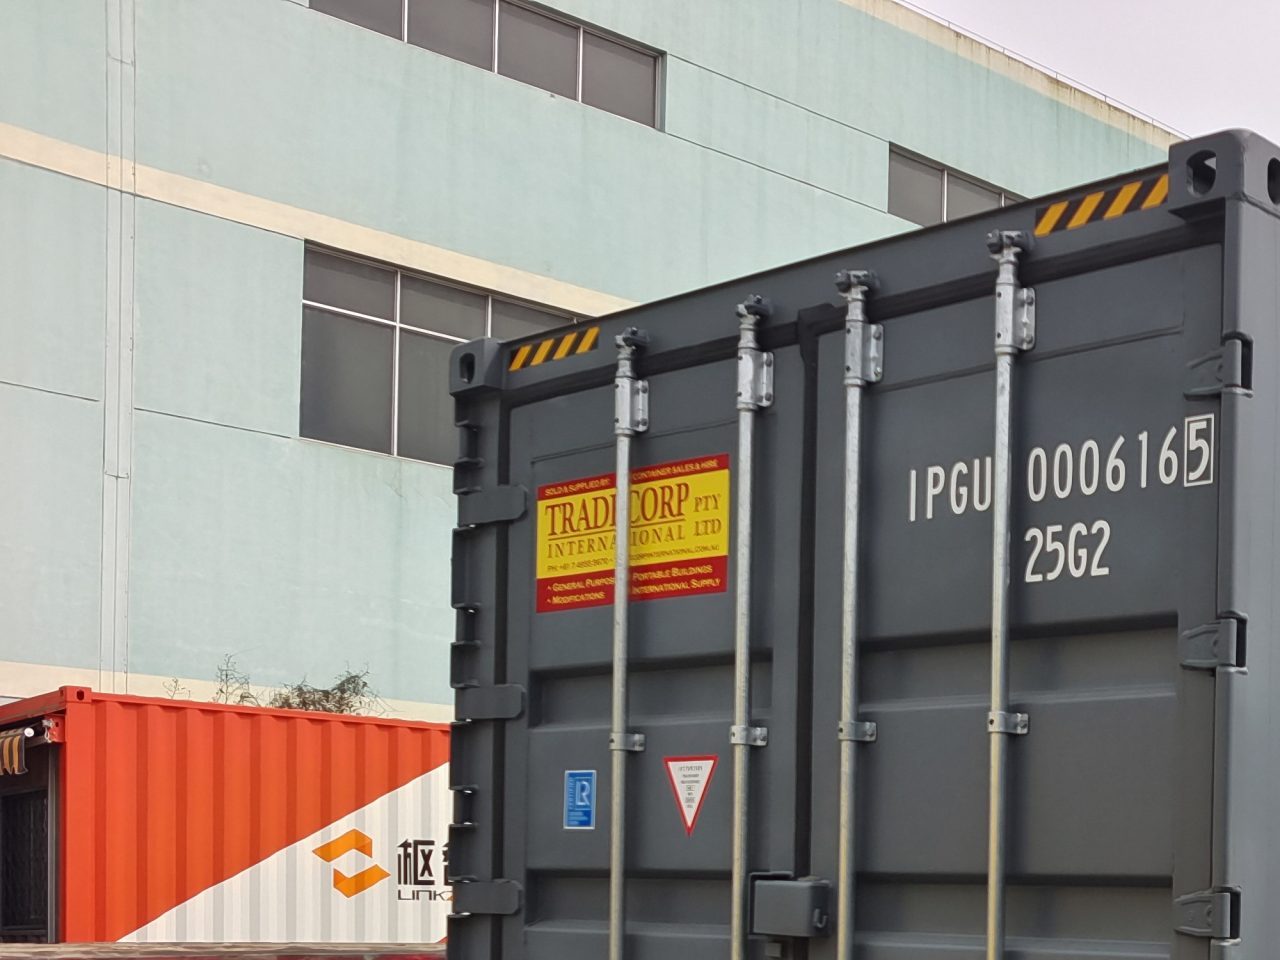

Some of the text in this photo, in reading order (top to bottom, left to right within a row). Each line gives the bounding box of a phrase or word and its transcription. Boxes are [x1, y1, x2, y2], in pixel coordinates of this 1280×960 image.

[909, 456, 992, 522] IPGU
[693, 518, 722, 537] LTD
[1024, 519, 1111, 583] 25G2
[633, 569, 672, 581] PORTABLE
[671, 564, 713, 577] BUILDINGS
[552, 591, 606, 605] MODIFICATIONS
[690, 578, 721, 589] SUPPLY
